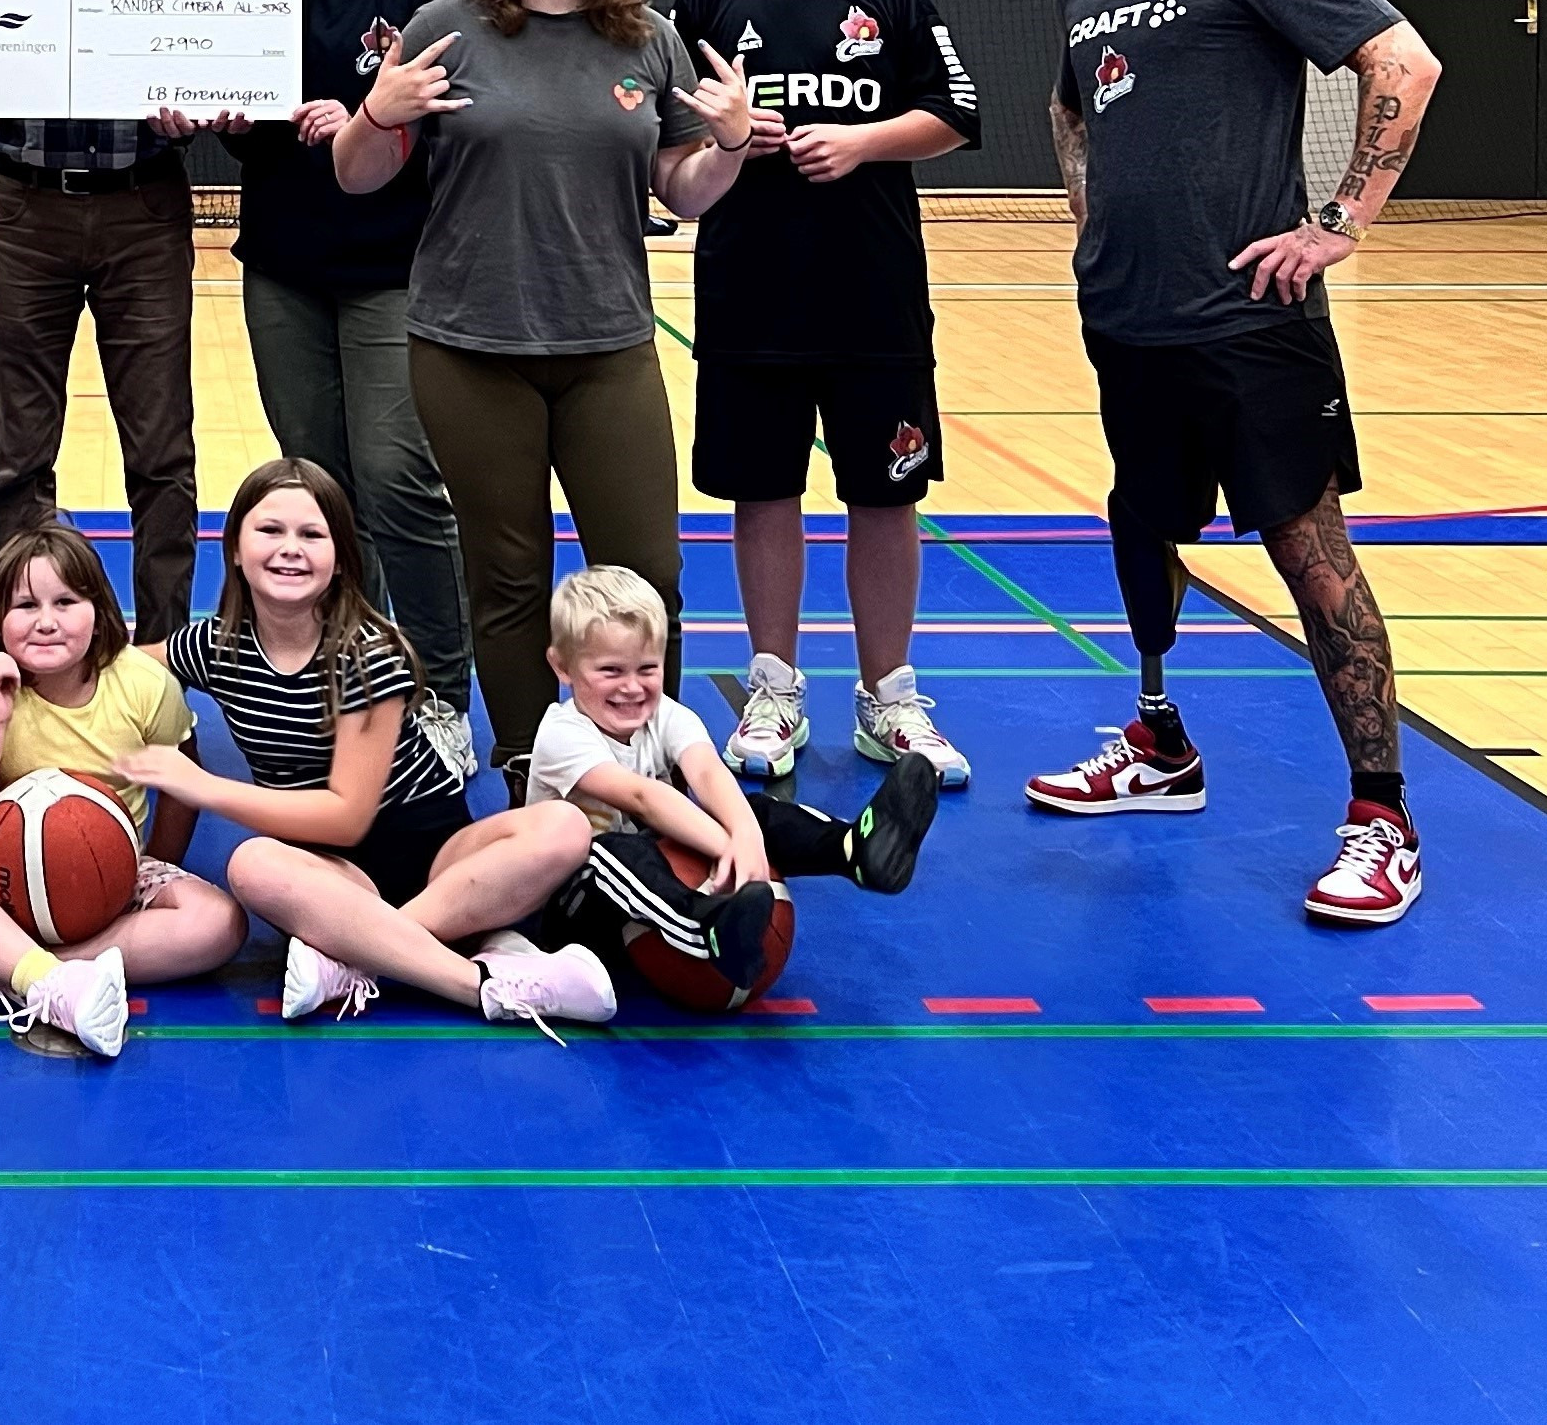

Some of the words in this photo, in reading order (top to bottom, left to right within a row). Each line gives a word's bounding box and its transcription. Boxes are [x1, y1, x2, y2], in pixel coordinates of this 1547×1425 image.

[172, 0, 225, 13] CIMBRIA
[1069, 1, 1152, 48] CRAFT
[150, 36, 214, 52] 27990
[147, 85, 167, 102] LB
[174, 85, 280, 106] Foreningen
